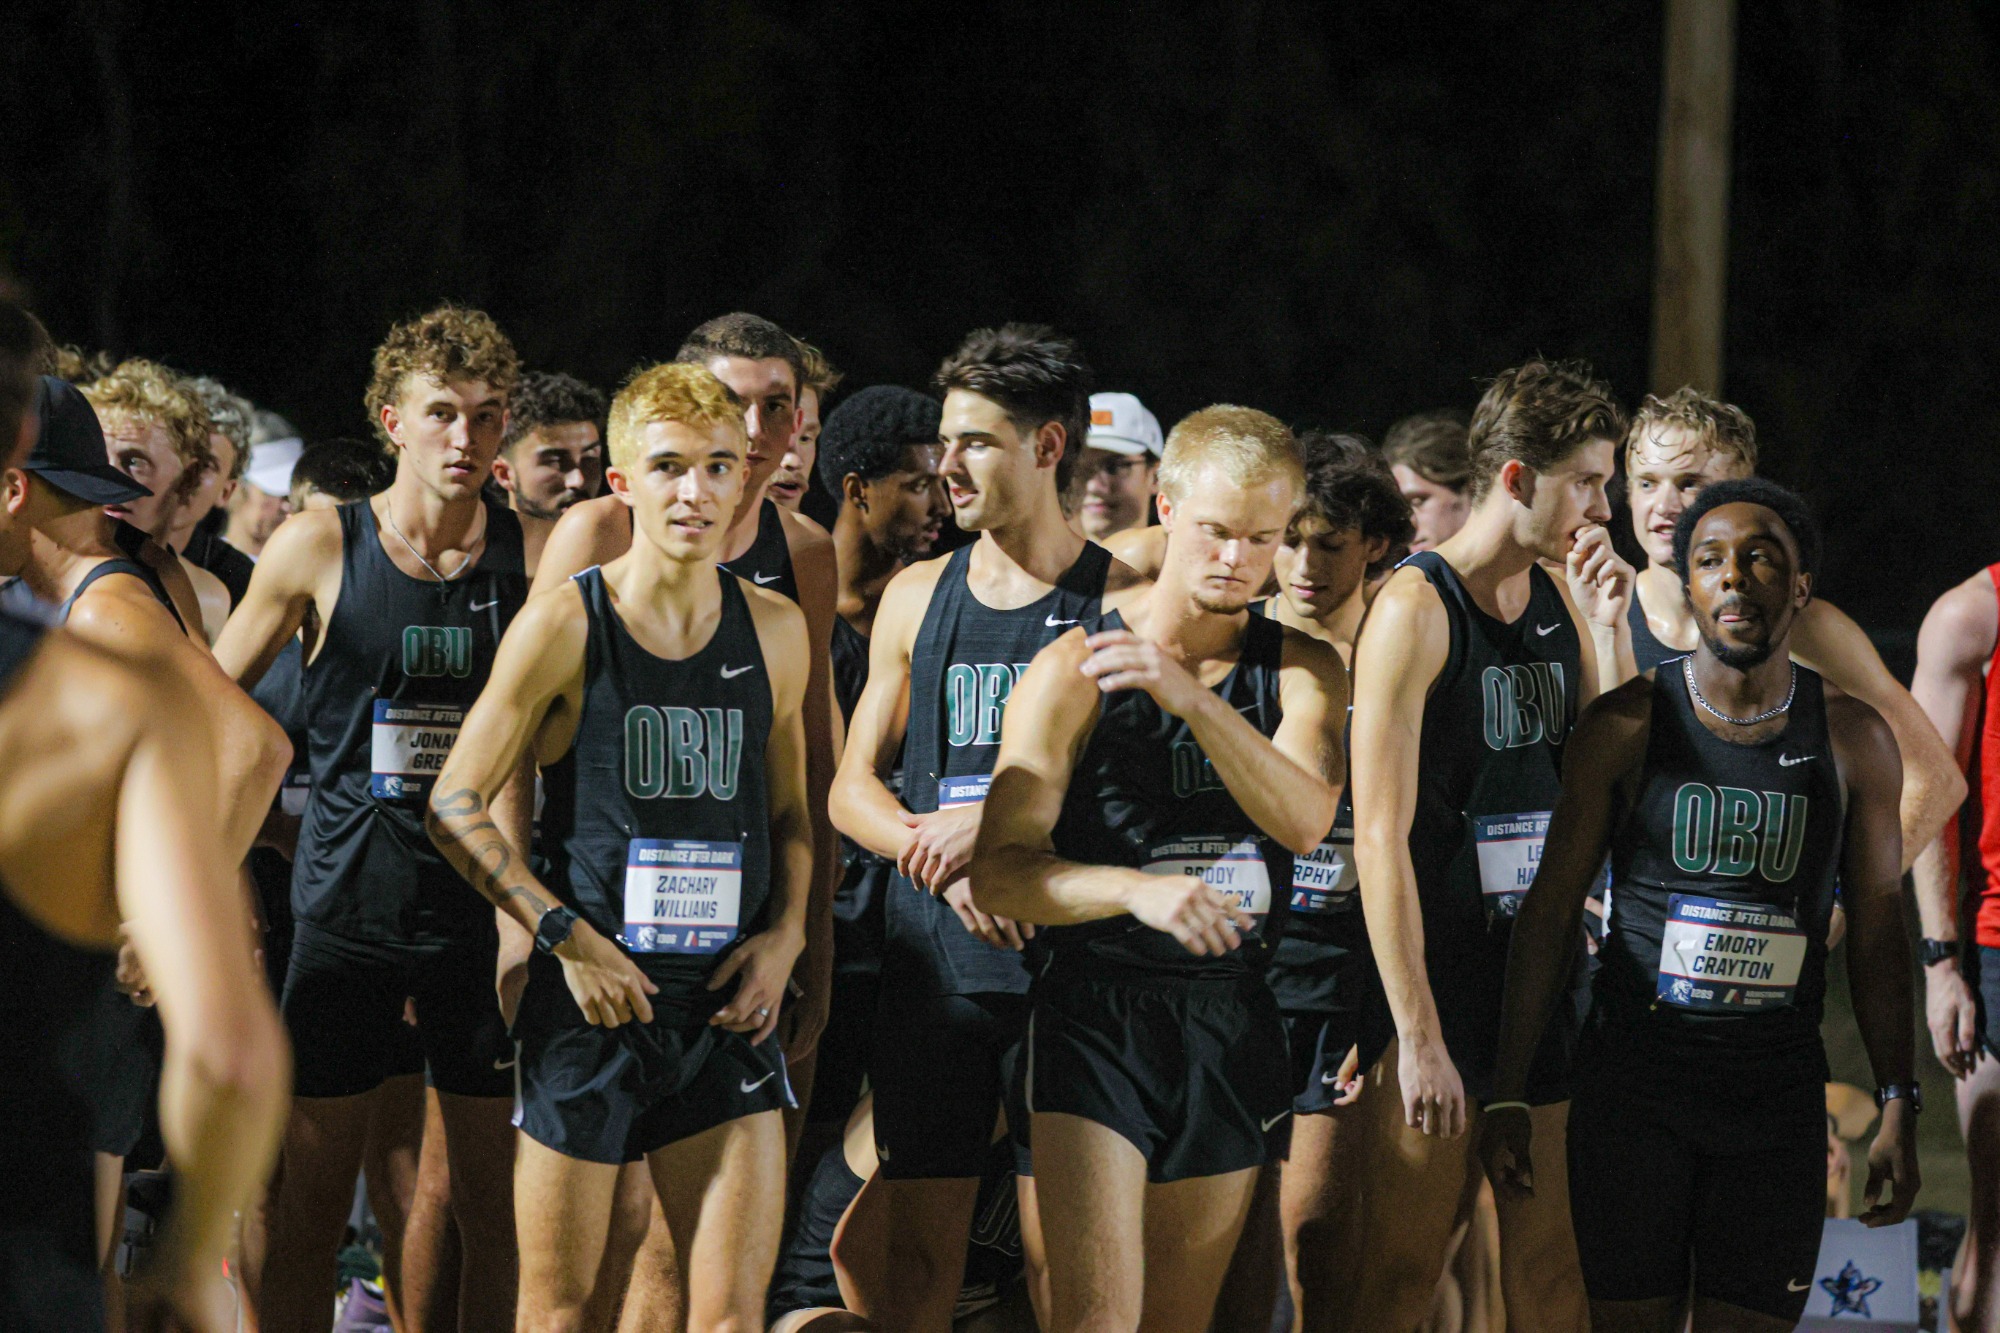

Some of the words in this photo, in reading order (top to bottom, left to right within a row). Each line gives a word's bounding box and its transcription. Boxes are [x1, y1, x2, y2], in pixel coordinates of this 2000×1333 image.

[402, 625, 472, 678] OBU
[947, 663, 1031, 746] OB
[1482, 662, 1565, 751] OBU
[413, 753, 448, 769] GRE
[624, 705, 743, 801] OBU
[950, 784, 989, 798] DISTANC
[1487, 821, 1533, 836] DISTANCE
[1535, 820, 1550, 832] AFT
[1672, 782, 1808, 882] OBU
[638, 848, 689, 863] DISTANCE
[1201, 842, 1230, 854] AFTER
[1528, 845, 1543, 862] LE
[1294, 864, 1336, 885] RPHY
[1517, 867, 1537, 885] HA
[656, 875, 718, 895] ZACHARY
[654, 899, 718, 919] WILLIAMS
[1680, 904, 1733, 922] DISTANCE
[1733, 911, 1768, 926] AFTER
[1704, 932, 1769, 956] EMORY
[1693, 955, 1775, 980] CRAYTON
